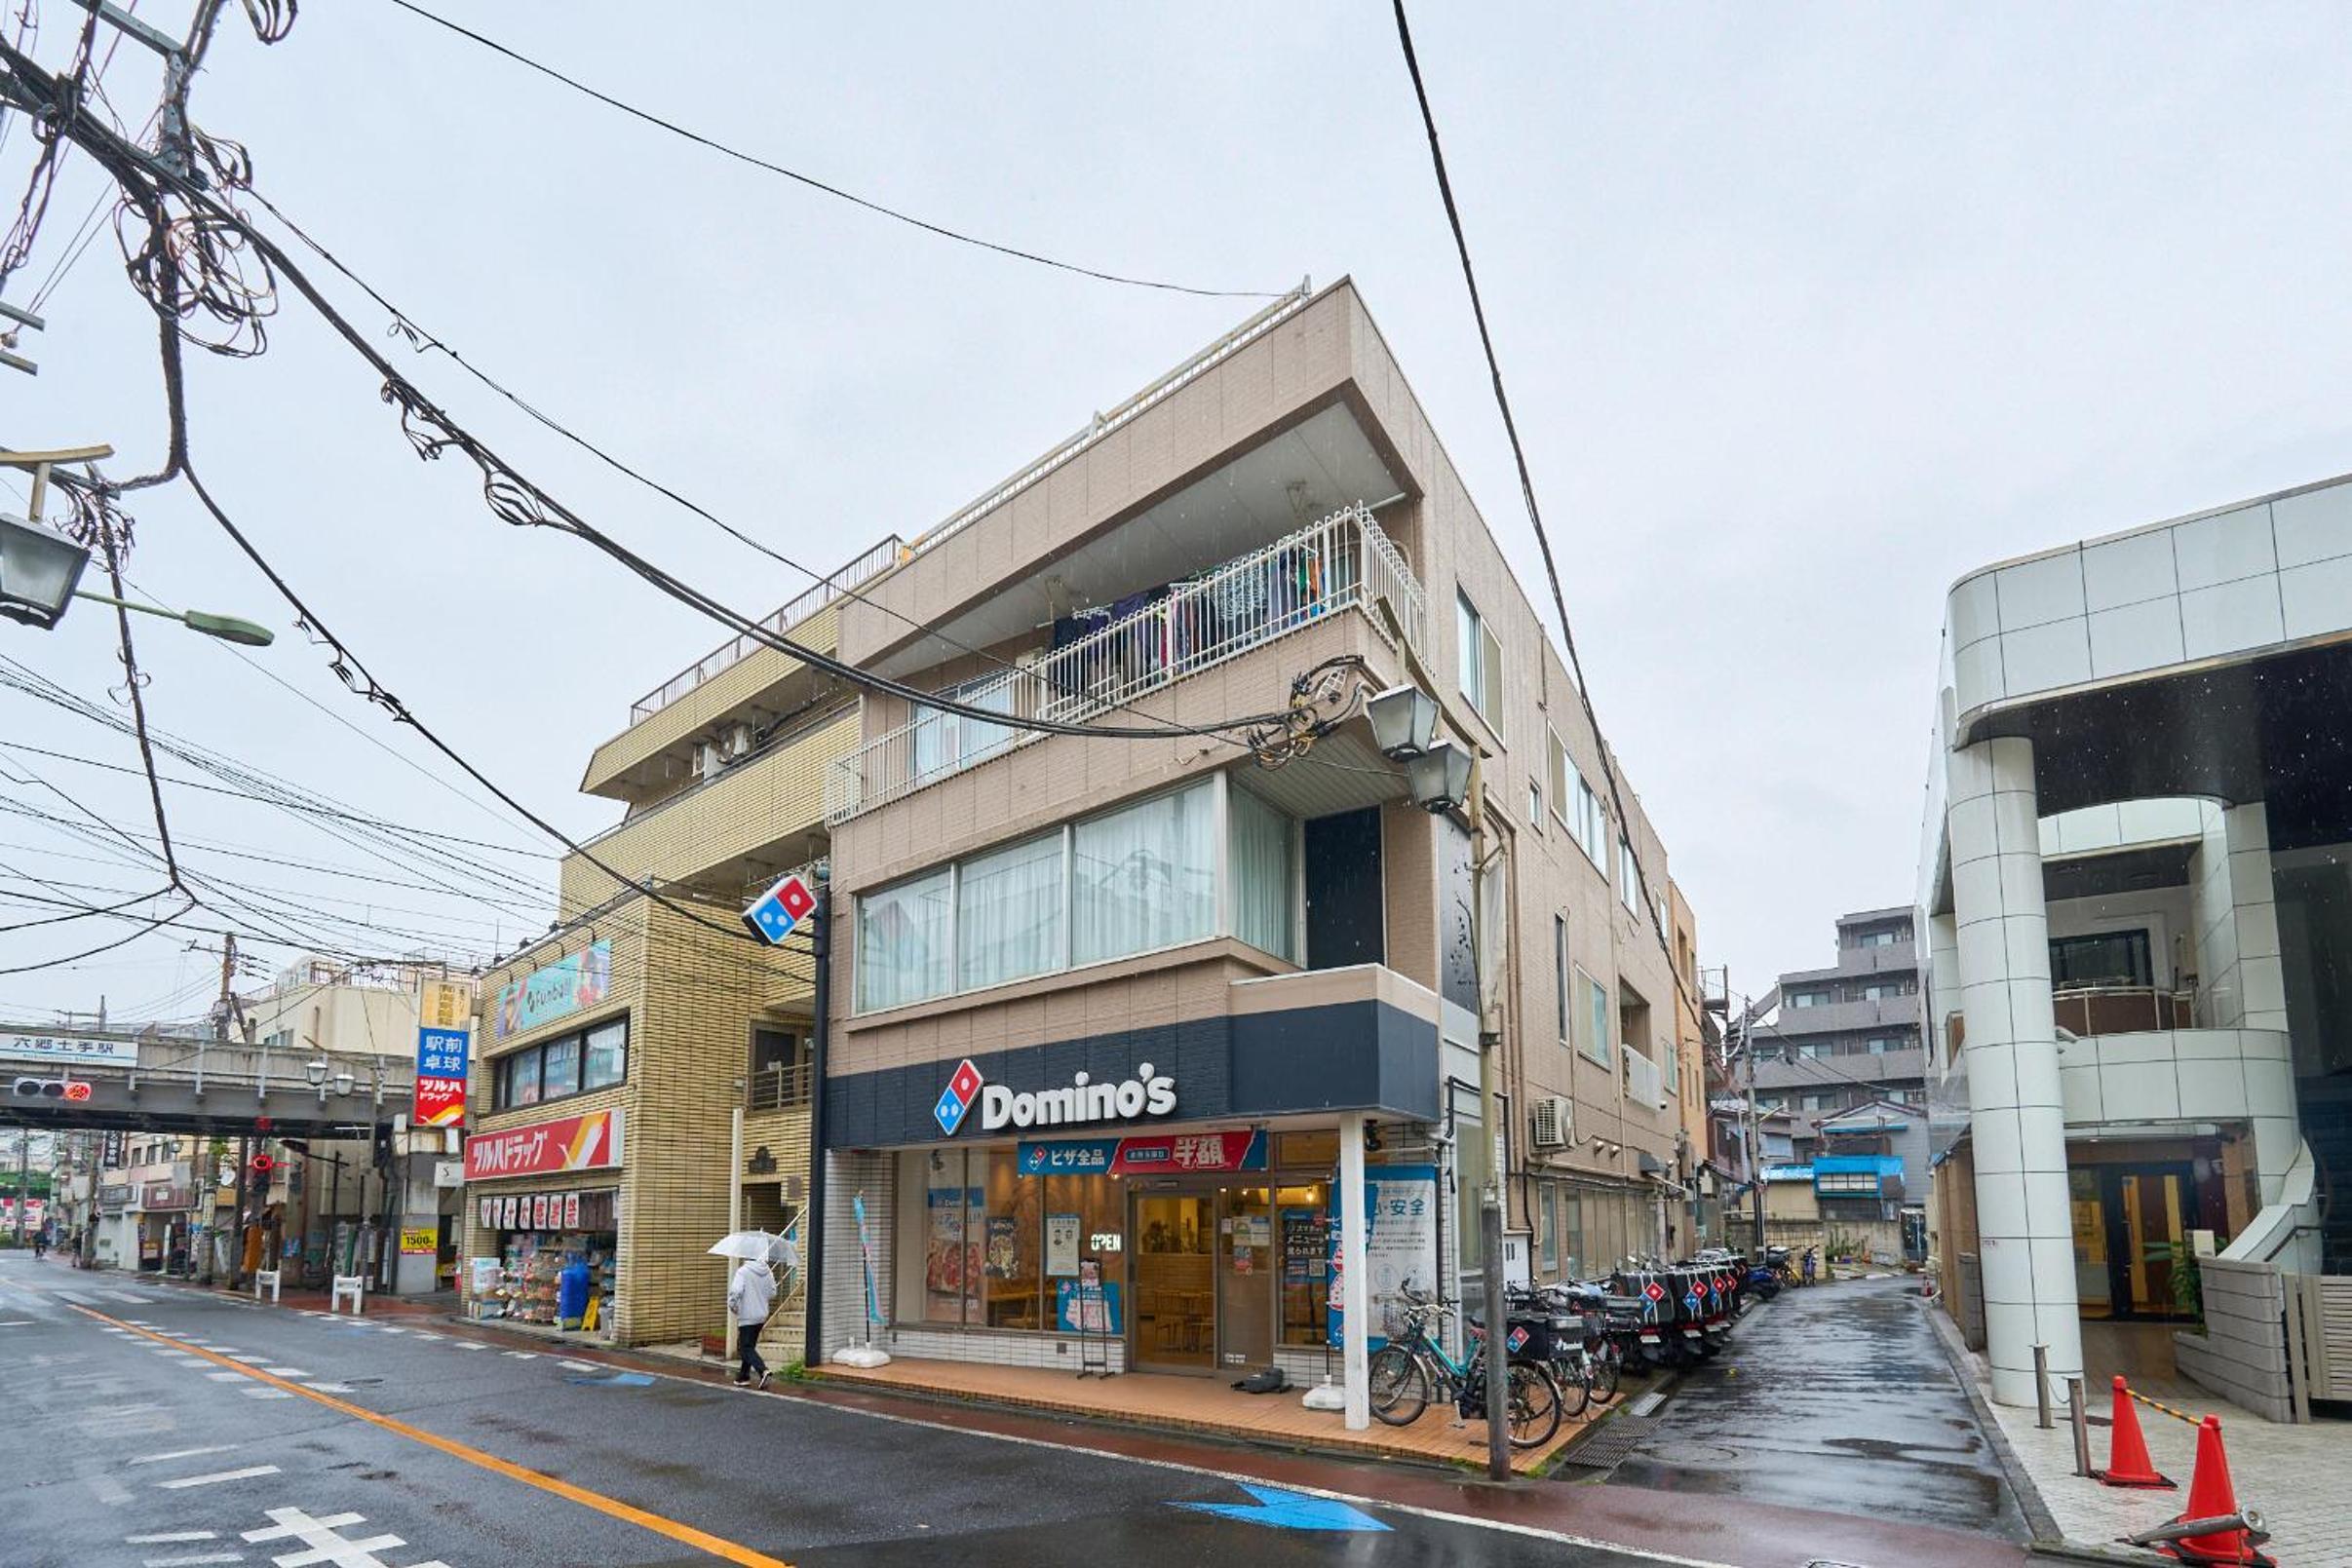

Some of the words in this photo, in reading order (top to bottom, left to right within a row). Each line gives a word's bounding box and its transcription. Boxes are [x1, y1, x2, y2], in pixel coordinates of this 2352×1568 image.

[13, 1036, 115, 1054] 六郷土手駅
[425, 1035, 463, 1053] 駅前
[423, 1055, 461, 1072] 卓球
[419, 1079, 463, 1093] ツルハ
[419, 1092, 453, 1102] ドラッグ
[983, 1062, 1176, 1129] Domino's
[473, 1129, 549, 1173] ツルハドラッグ
[1051, 1148, 1105, 1166] ピザ全品
[1173, 1135, 1225, 1168] 半額
[1091, 1233, 1122, 1252] OPEN
